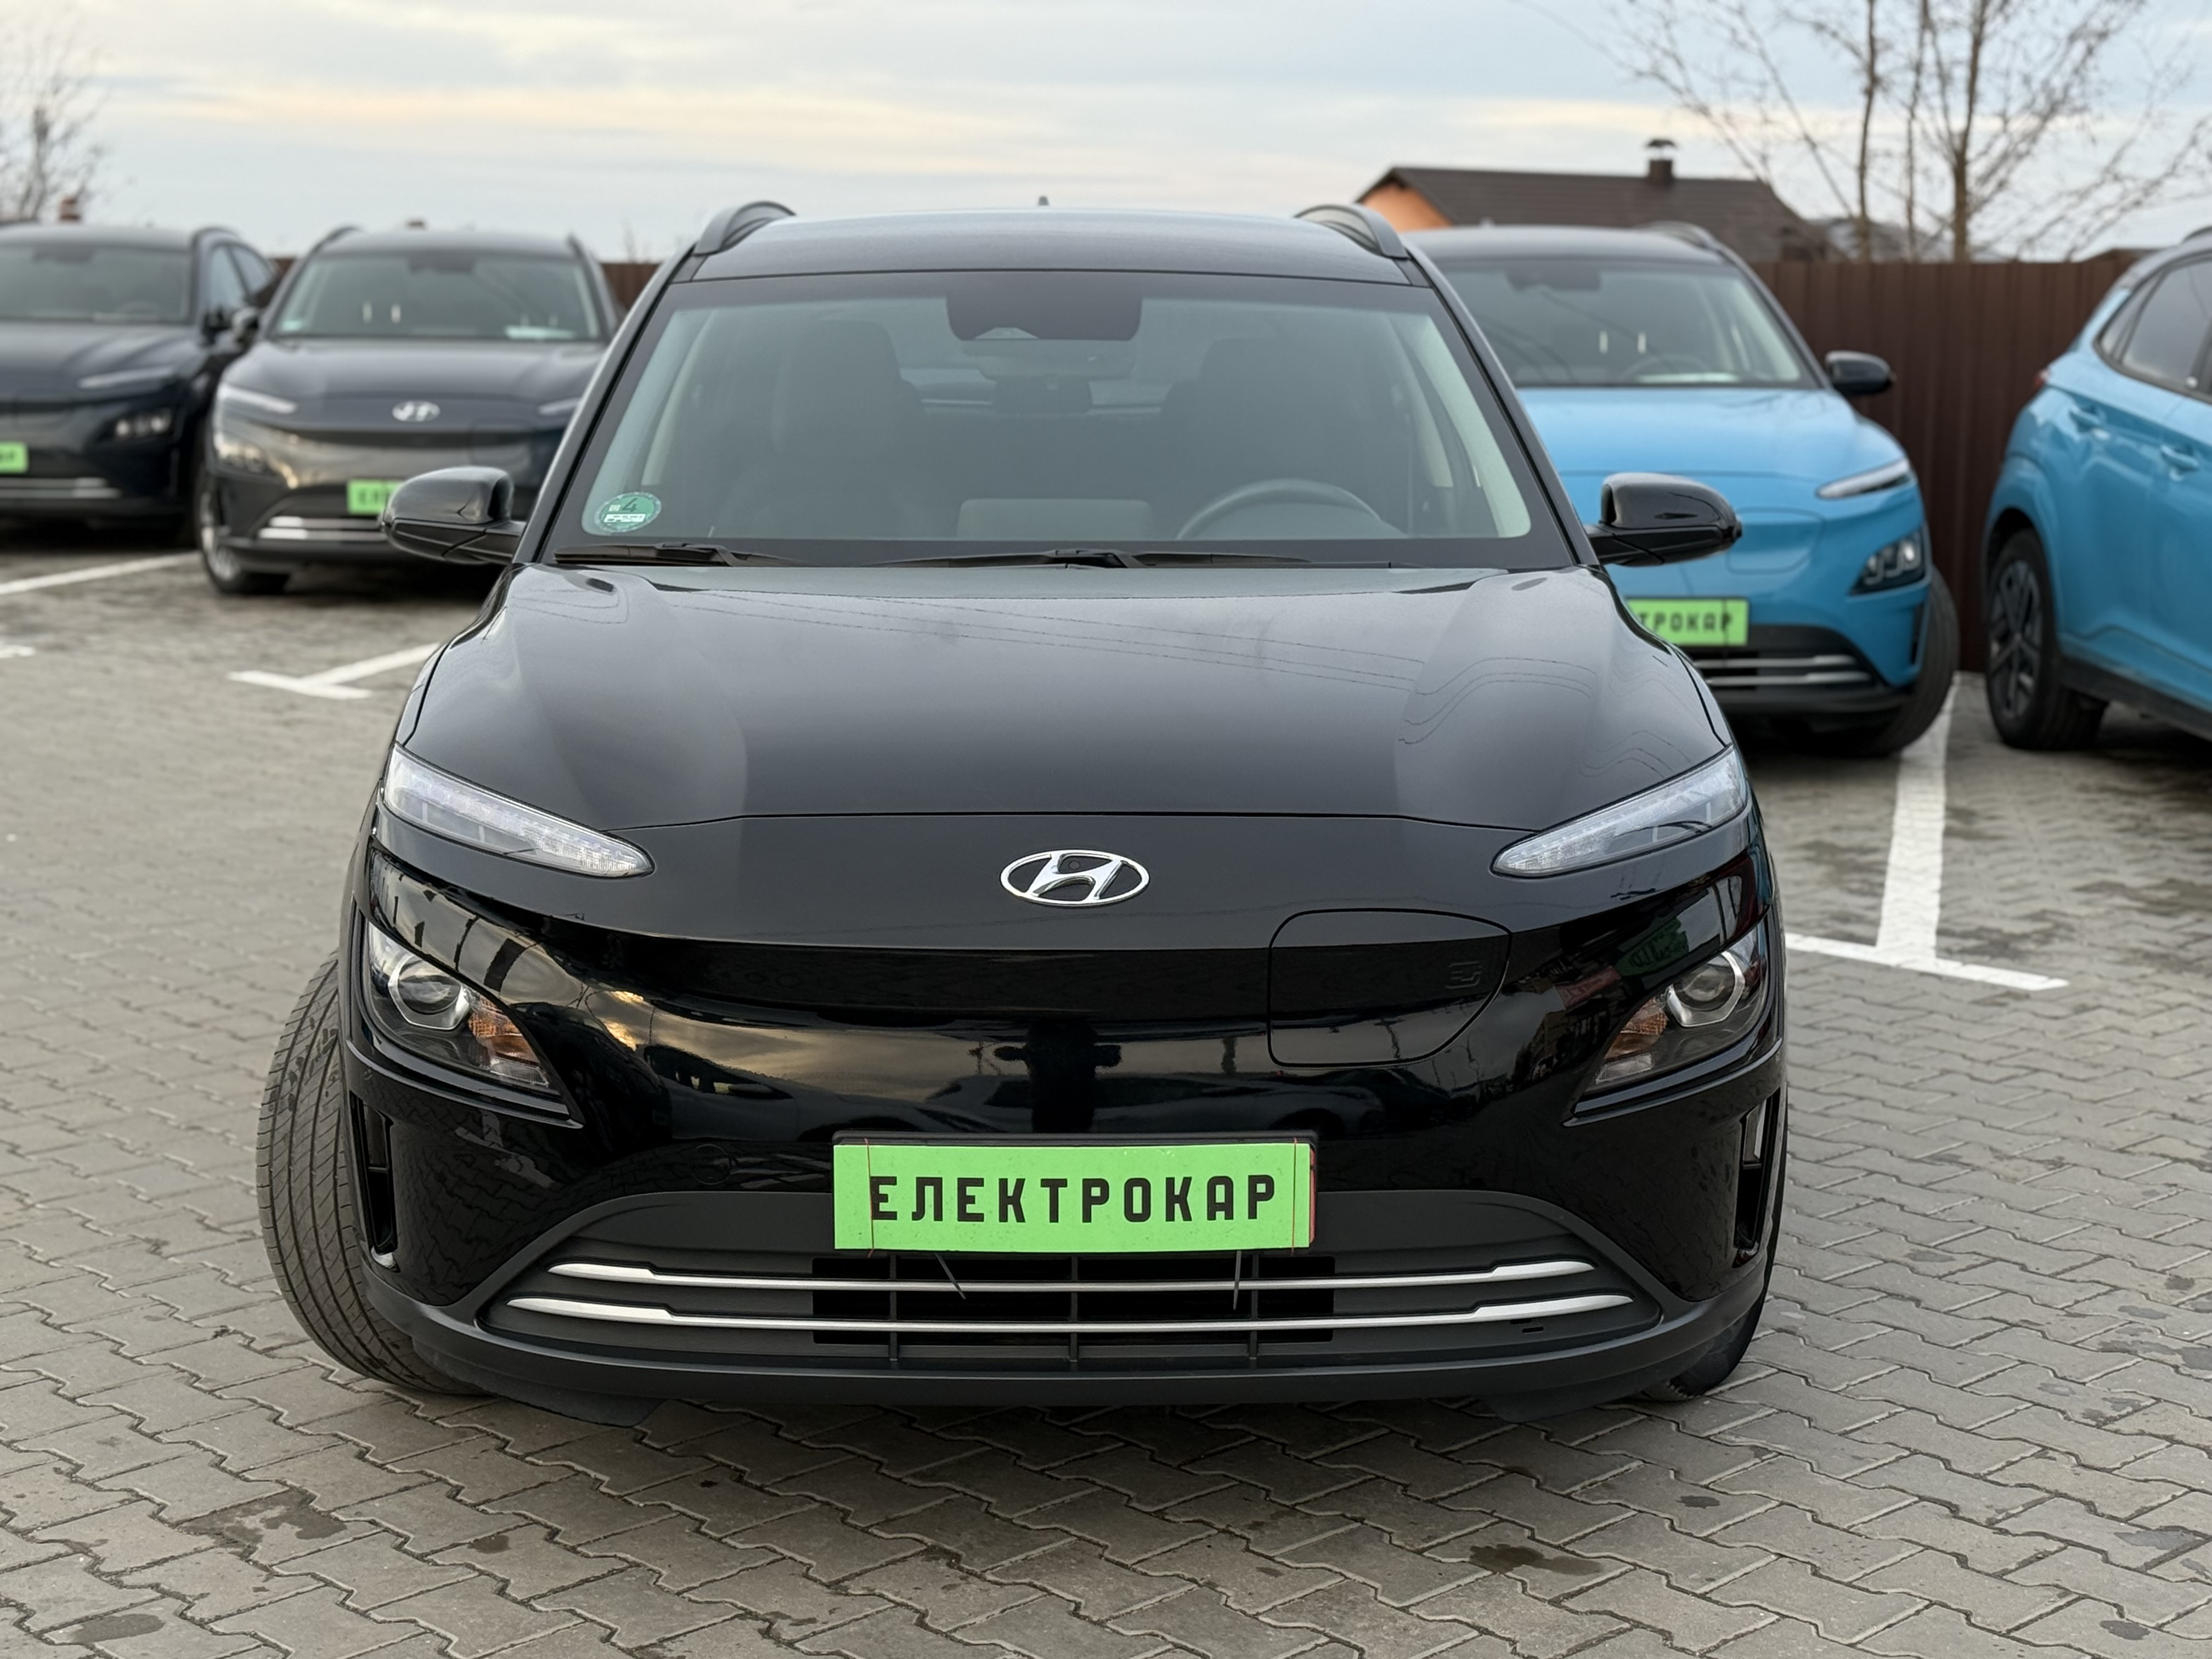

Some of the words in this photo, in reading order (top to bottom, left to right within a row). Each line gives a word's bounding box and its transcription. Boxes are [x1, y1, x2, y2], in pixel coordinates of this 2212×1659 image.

[622, 498, 637, 512] 4
[1638, 612, 1732, 631] ТРОКАР
[871, 1175, 1274, 1222] ЕЛЕКТРОКАР
